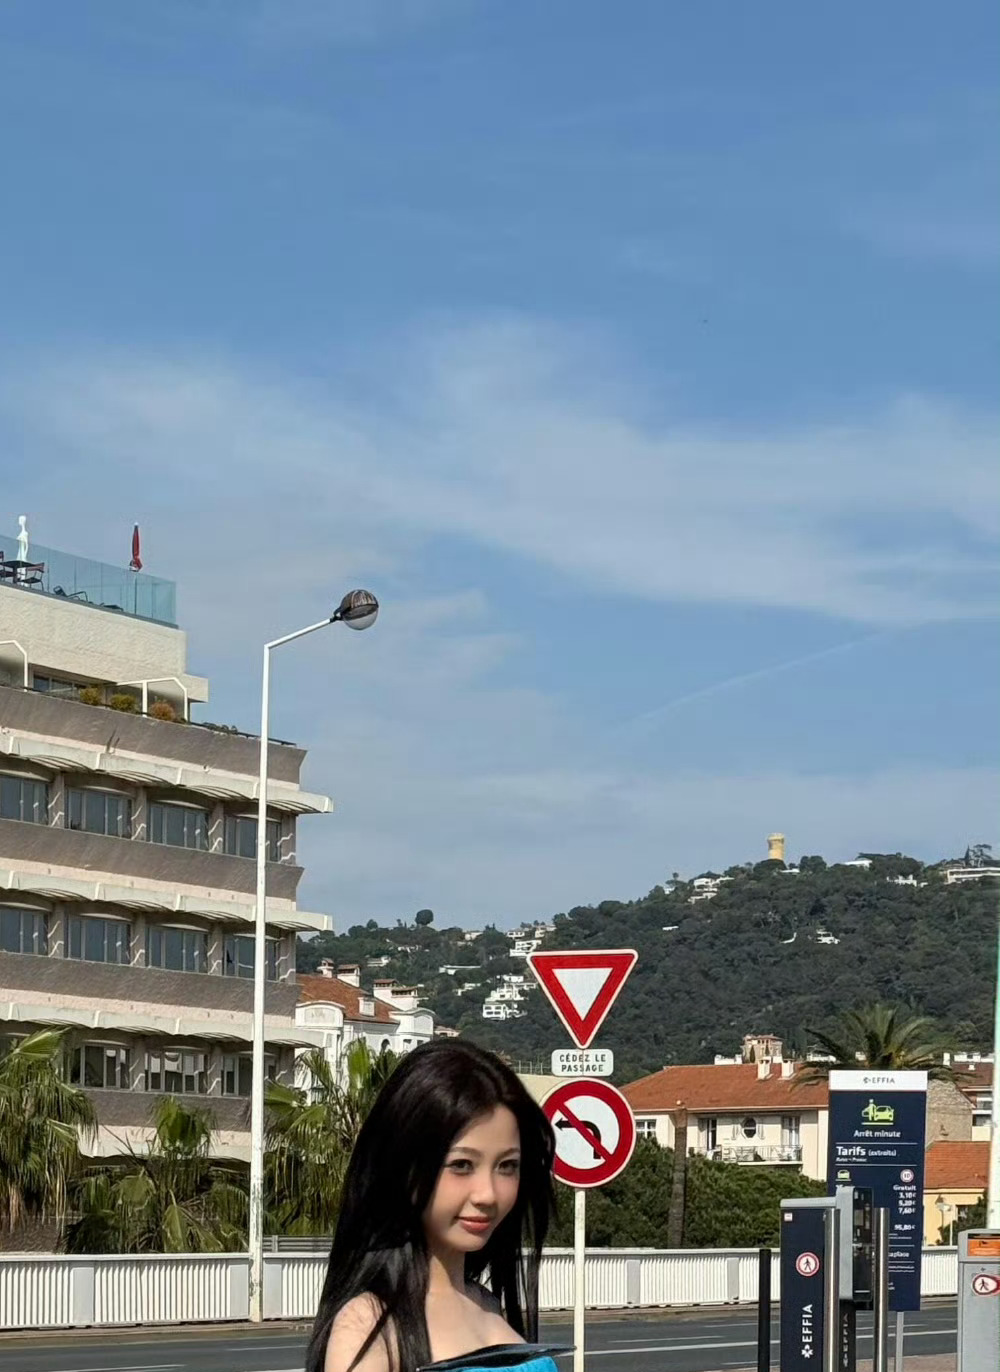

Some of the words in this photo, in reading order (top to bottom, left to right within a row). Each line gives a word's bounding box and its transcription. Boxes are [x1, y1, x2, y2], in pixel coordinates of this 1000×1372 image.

[559, 1053, 591, 1063] CÉDEZ
[595, 1054, 606, 1063] LE
[561, 1064, 604, 1072] PASSAGE
[853, 1129, 873, 1138] Arrêt
[874, 1129, 901, 1138] minute
[835, 1146, 867, 1156] Tarifs
[802, 1304, 813, 1343] EFFIA
